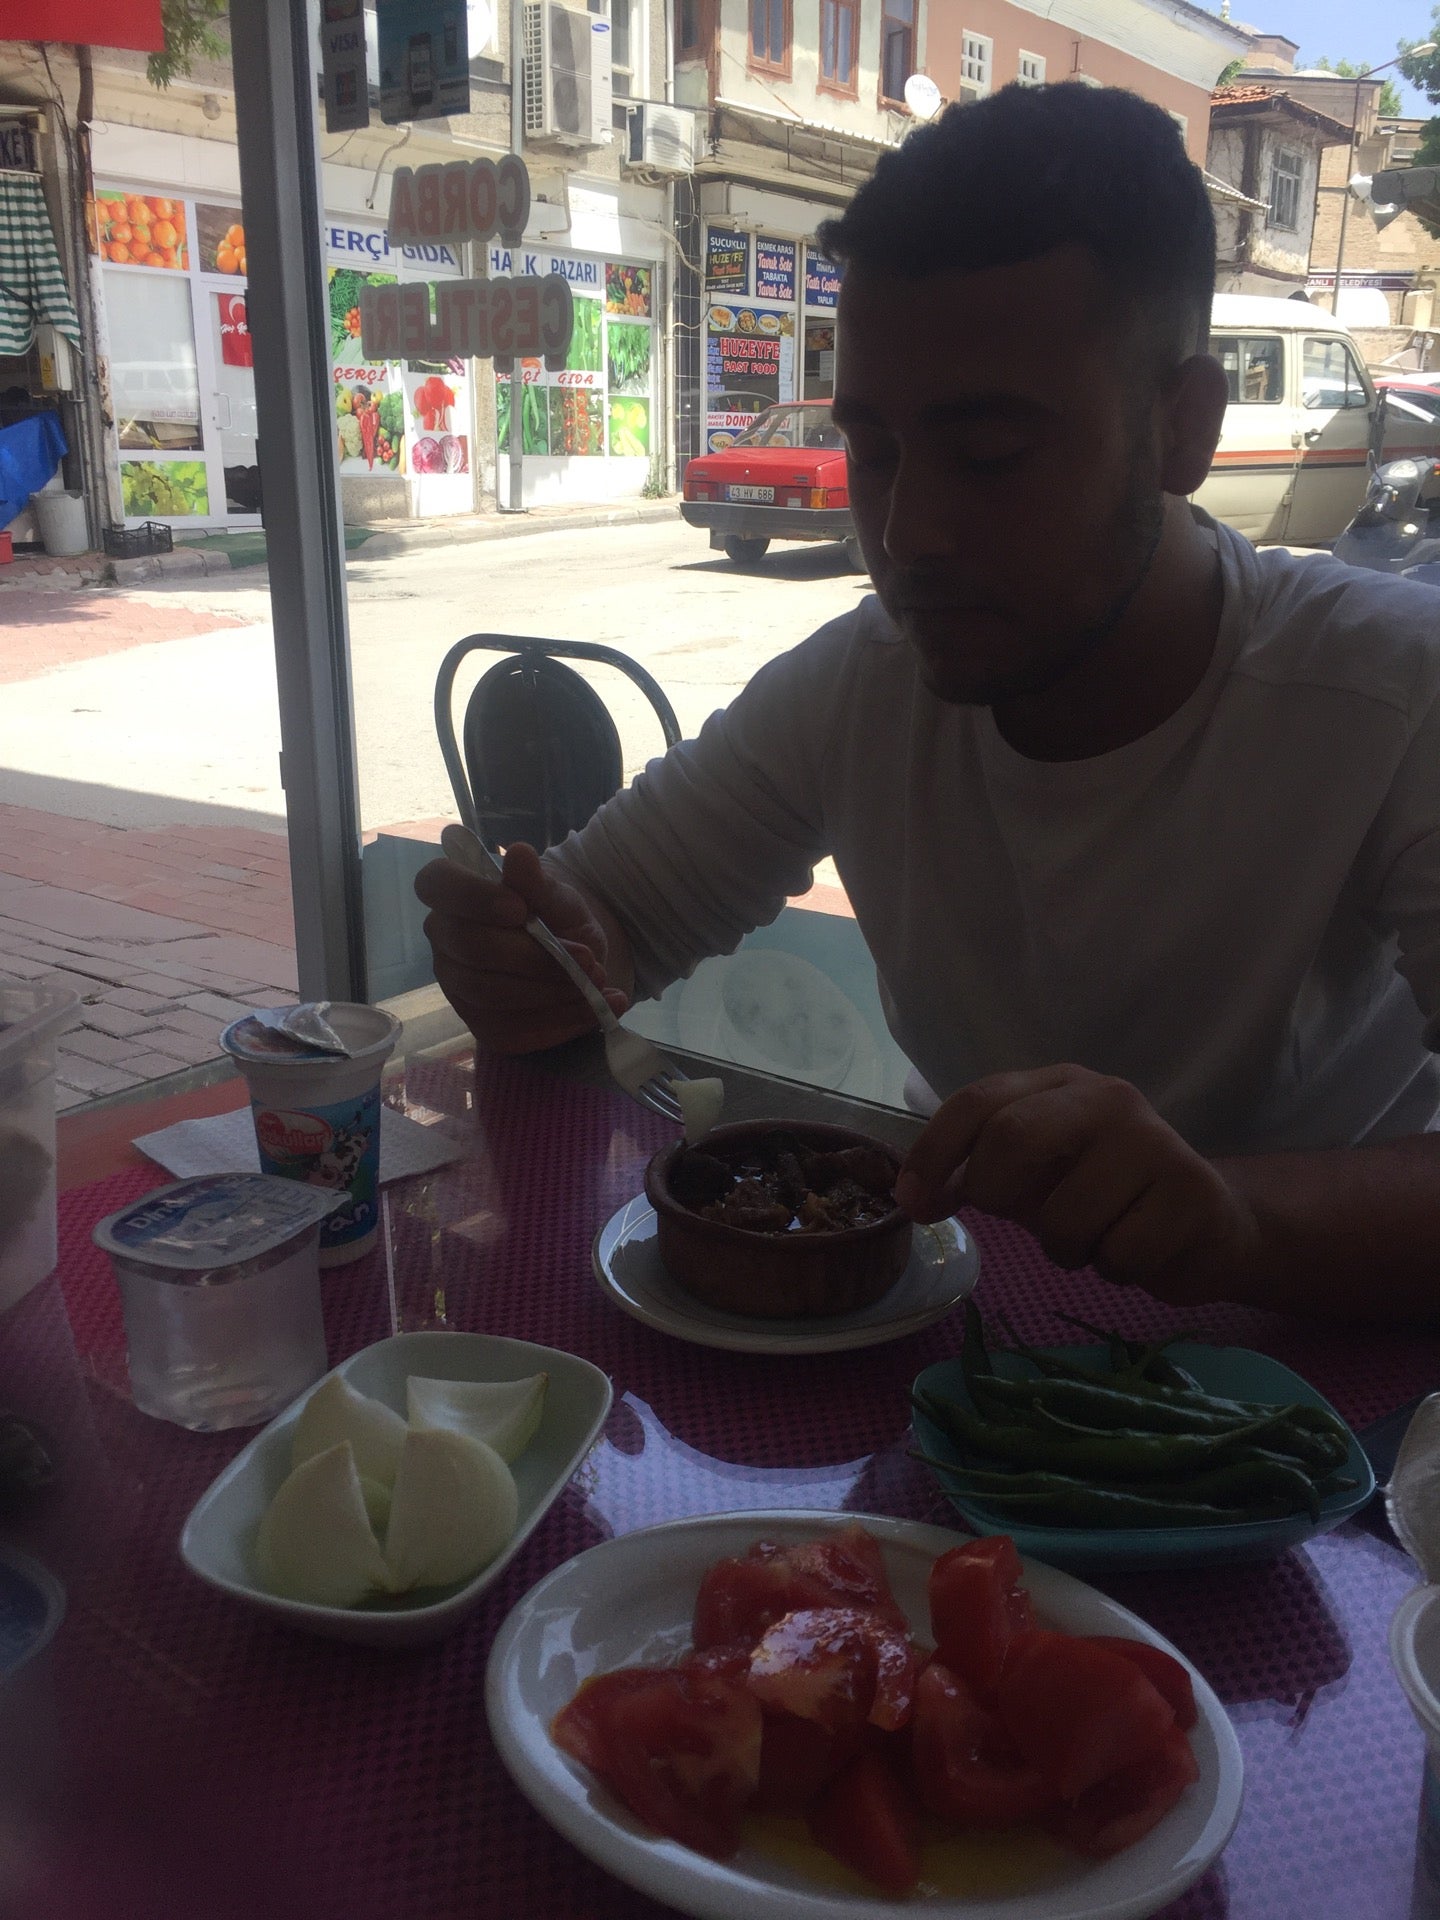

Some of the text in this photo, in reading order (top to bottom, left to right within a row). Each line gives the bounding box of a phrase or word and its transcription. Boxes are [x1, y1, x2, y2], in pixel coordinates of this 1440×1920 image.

[329, 32, 359, 53] VISA
[325, 227, 389, 260] ERÇİ
[710, 237, 746, 250] SUCUKLU
[757, 241, 777, 253] EKMEK
[491, 250, 597, 284] HAK PAZARI
[762, 271, 788, 283] TABAKTA
[720, 336, 780, 360] HUZEYFE
[723, 360, 749, 373] FAST
[750, 362, 777, 375] FOOD
[333, 367, 388, 386] ÇERÇİ
[557, 373, 594, 385] GIDA
[731, 487, 773, 500] 43 HV 686
